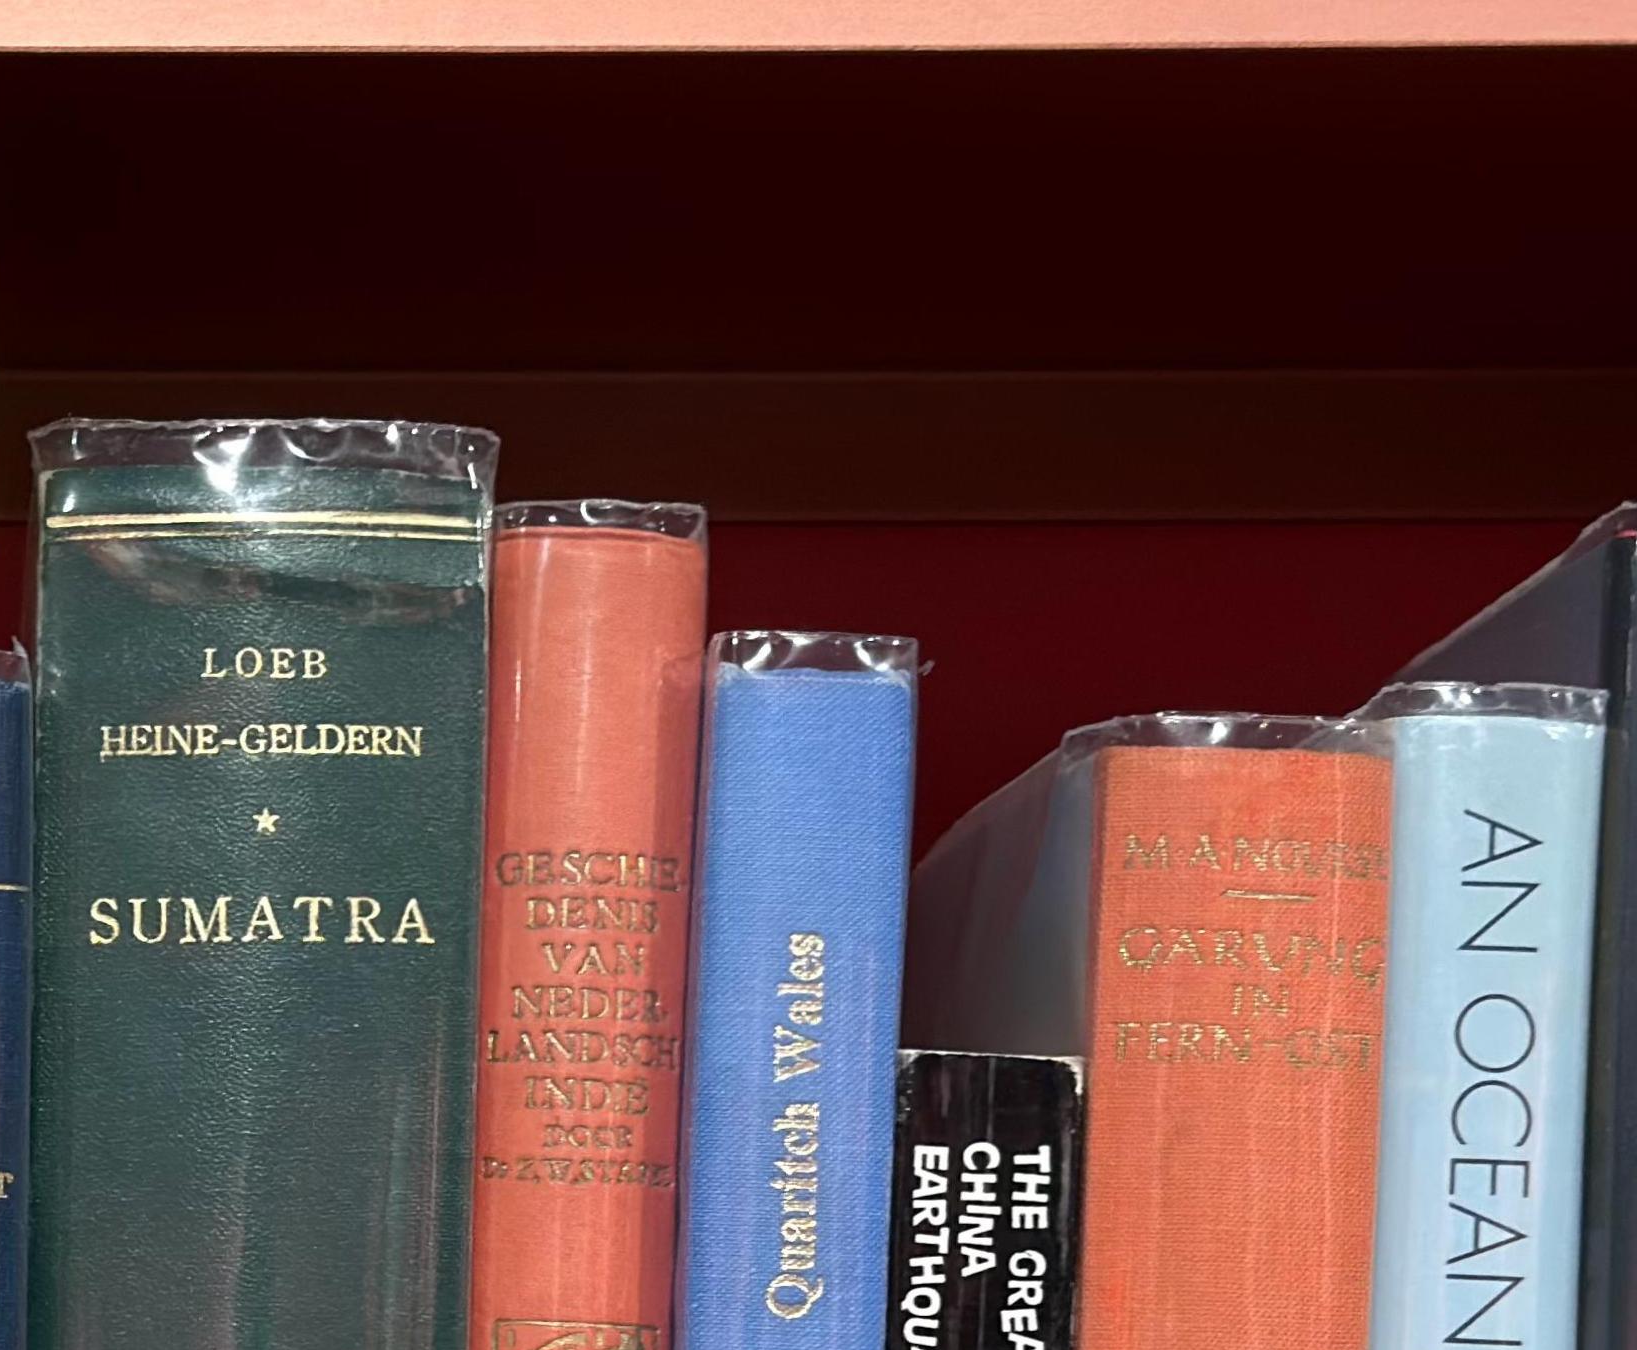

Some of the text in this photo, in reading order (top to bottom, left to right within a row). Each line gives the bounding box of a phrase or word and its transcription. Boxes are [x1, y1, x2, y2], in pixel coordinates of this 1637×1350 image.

[200, 647, 329, 680] LOEB
[99, 724, 423, 760] HEINE-GELDERN
[1456, 809, 1543, 953] AN
[88, 896, 436, 946] SUMATRA
[524, 896, 660, 933] DENIS
[541, 942, 645, 976] VAN
[1232, 985, 1289, 1018] IN
[486, 1030, 680, 1070] LANDSCH
[766, 933, 826, 1320] Quaritch Wales
[1011, 1145, 1051, 1230] THE
[1442, 993, 1537, 1346] OCEAN
[957, 1141, 1002, 1278] CHINA
